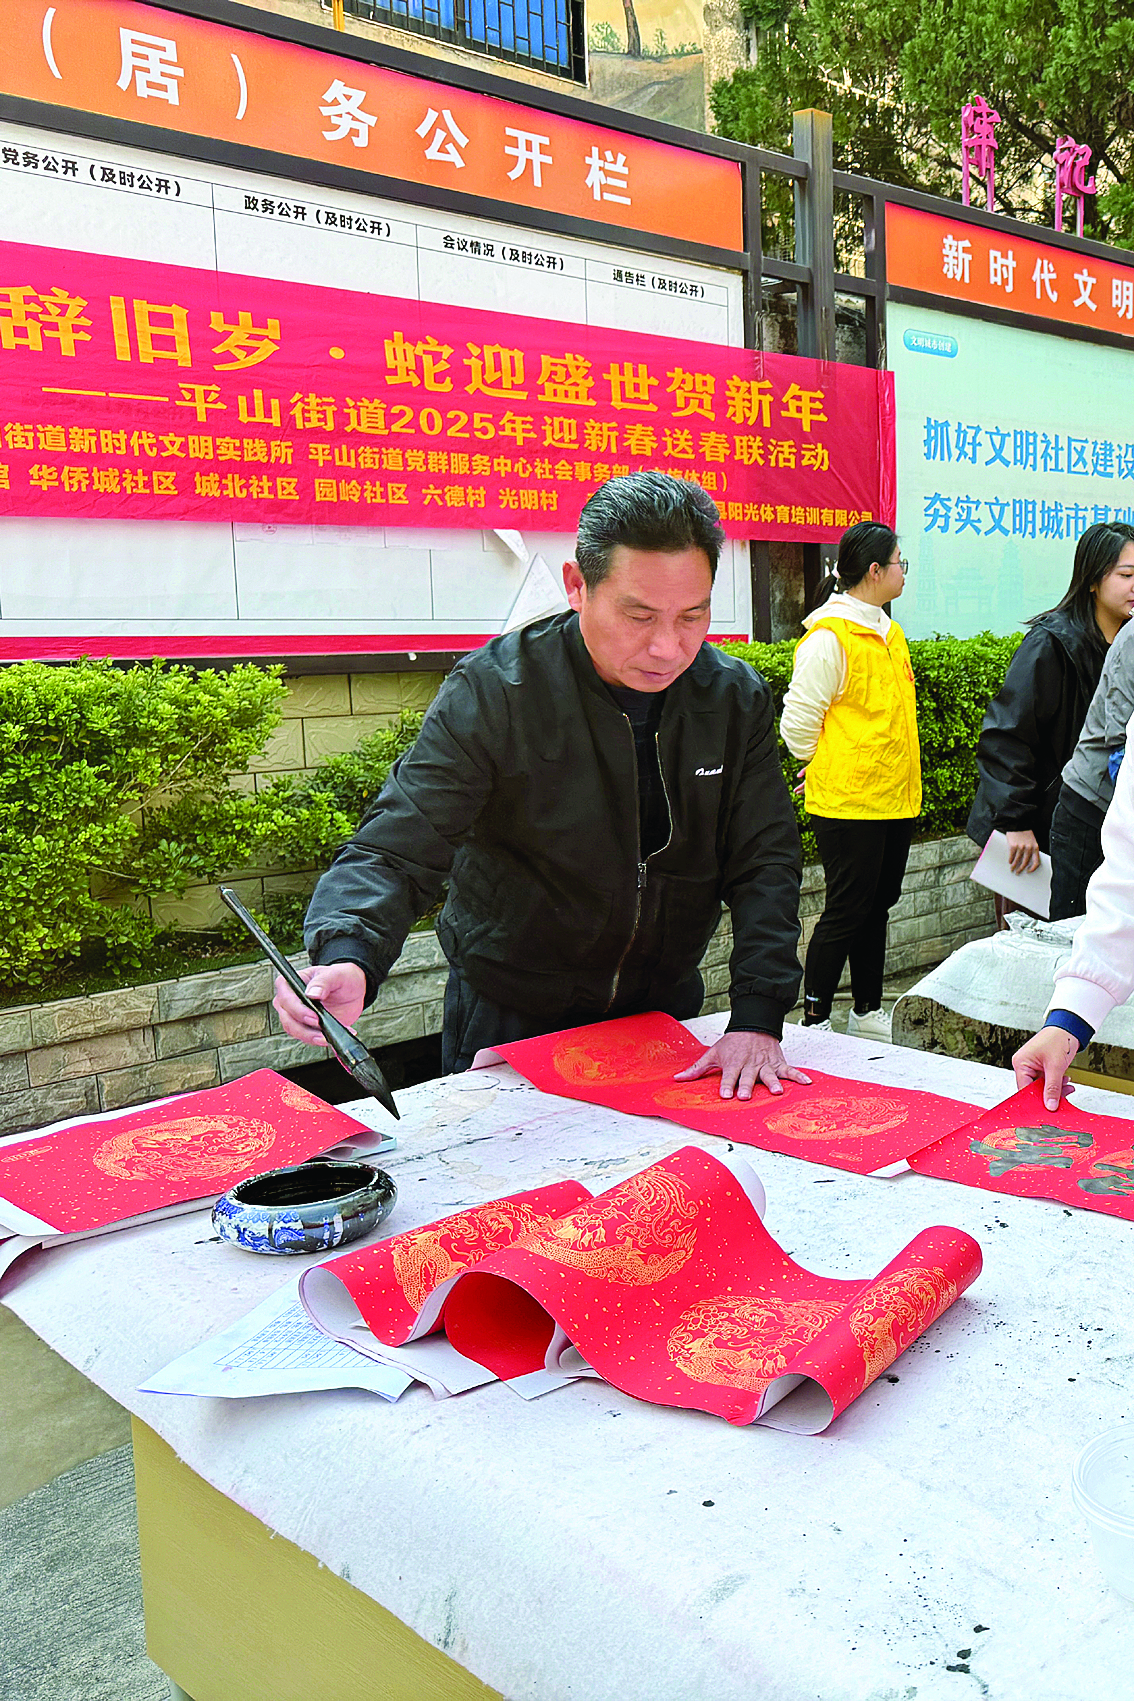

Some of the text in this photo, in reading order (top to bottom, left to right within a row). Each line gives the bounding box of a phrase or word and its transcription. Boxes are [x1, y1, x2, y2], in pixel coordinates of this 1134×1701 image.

[0, 422, 294, 465] 街道新时代文明实践所
[29, 463, 179, 496] 华侨城社区
[194, 471, 300, 500] 城北社区
[314, 478, 410, 505] 园岭社区
[421, 484, 487, 508] 六德村
[498, 487, 559, 512] 光明村
